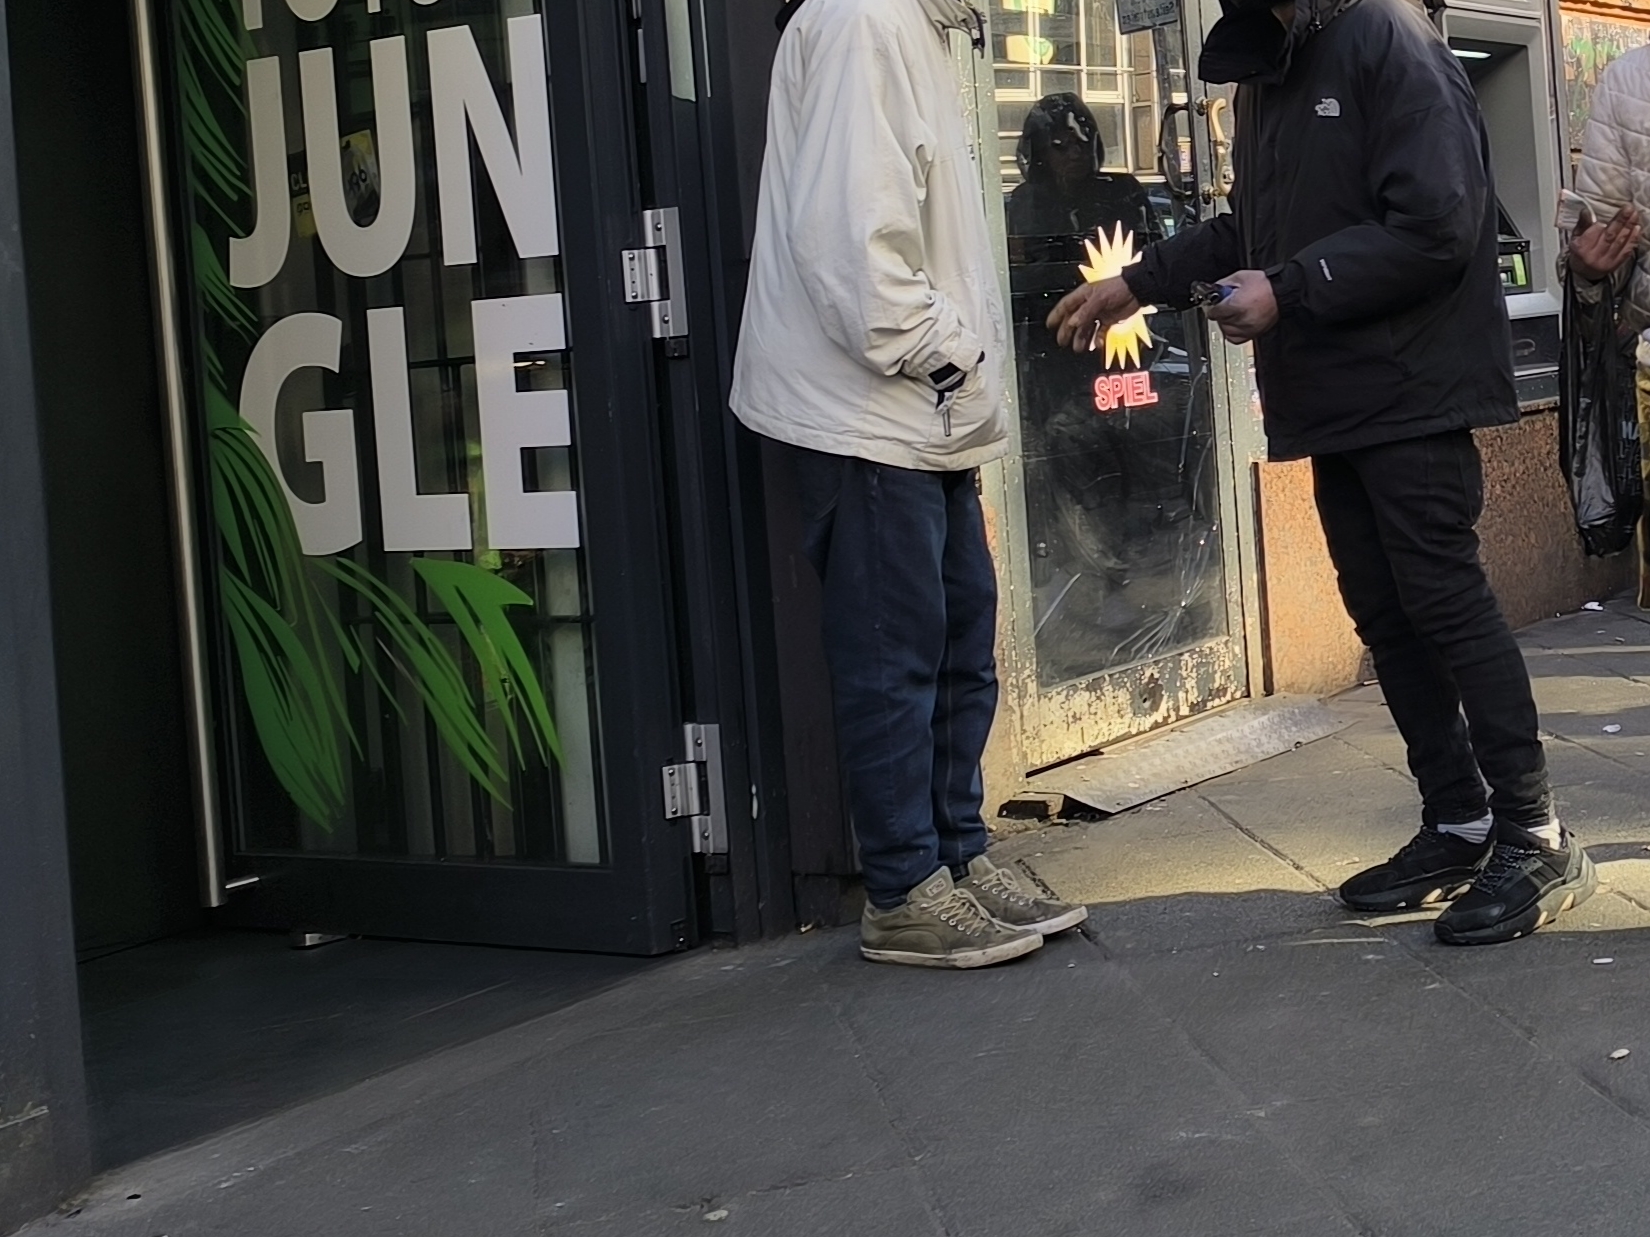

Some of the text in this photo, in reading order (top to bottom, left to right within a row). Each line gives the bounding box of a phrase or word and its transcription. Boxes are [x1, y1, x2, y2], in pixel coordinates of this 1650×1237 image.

[229, 14, 559, 289] JUN
[238, 293, 581, 556] GLE
[1093, 370, 1159, 412] SPIEL
